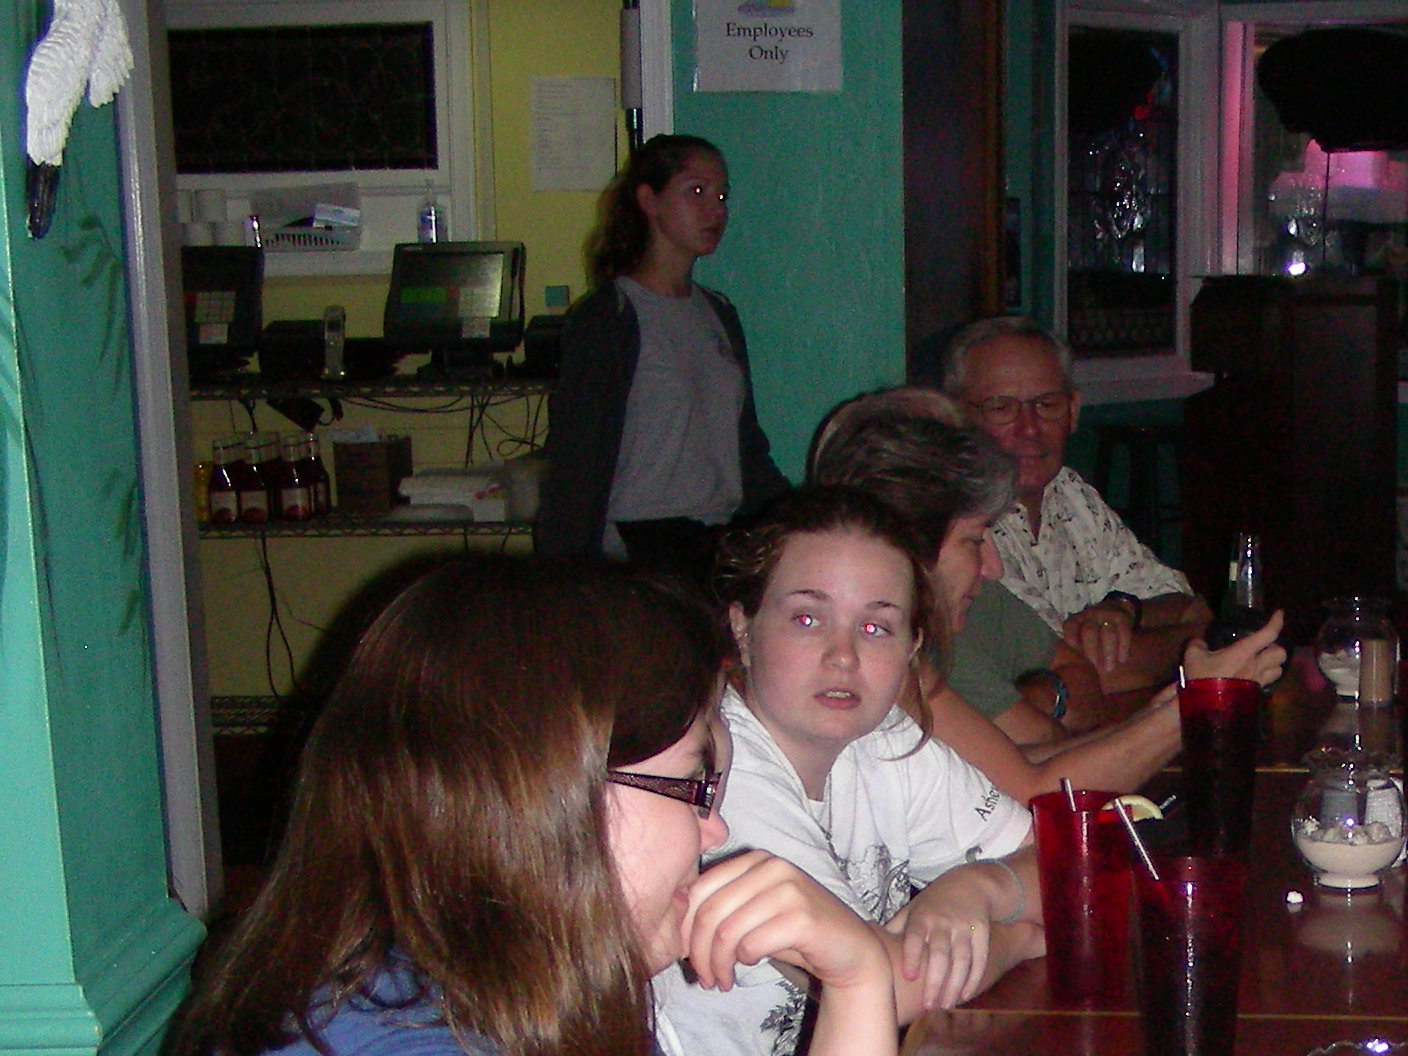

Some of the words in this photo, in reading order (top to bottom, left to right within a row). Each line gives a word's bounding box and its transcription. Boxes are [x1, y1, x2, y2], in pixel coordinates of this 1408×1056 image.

[726, 22, 814, 42] Employees
[749, 45, 789, 65] Only
[974, 784, 1001, 822] Ashe
